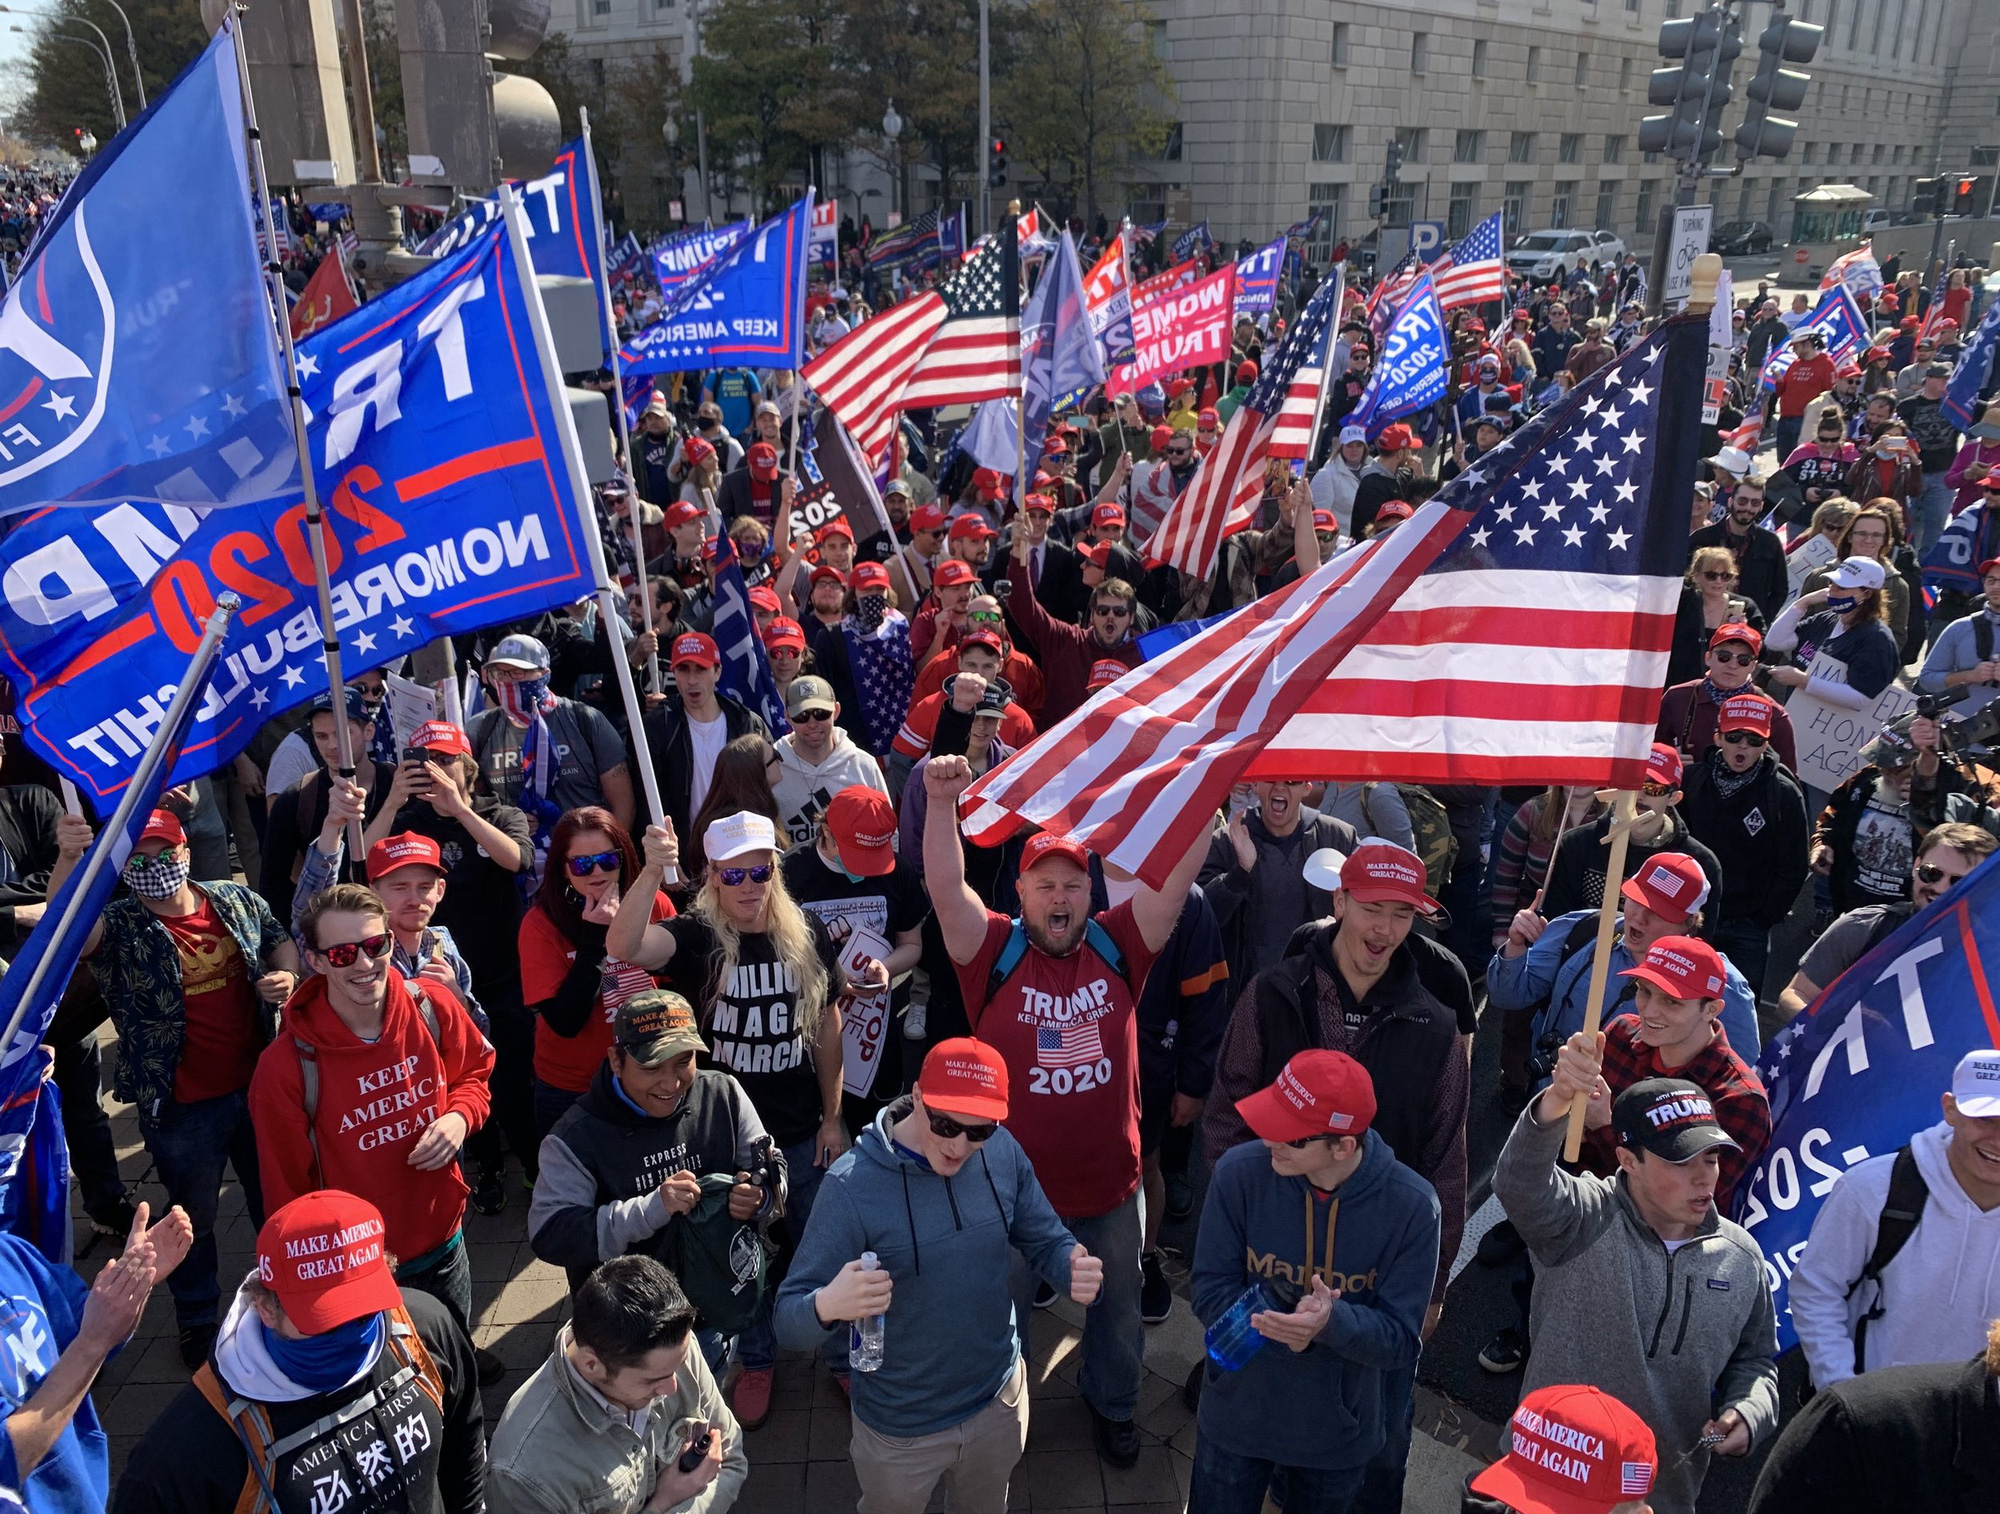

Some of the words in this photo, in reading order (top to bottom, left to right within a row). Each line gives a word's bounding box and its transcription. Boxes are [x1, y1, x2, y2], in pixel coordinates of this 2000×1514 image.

[1682, 218, 1704, 233] TURNING
[1413, 224, 1439, 249] P
[1101, 508, 1119, 518] USA
[1725, 701, 1742, 709] MAKE
[1743, 700, 1770, 712] AMERICA
[1727, 709, 1747, 718] GREAT
[1747, 710, 1767, 720] AGAIN
[427, 723, 456, 733] AMERICA
[431, 733, 453, 742] AGAIN
[1809, 707, 1877, 749] HON
[1803, 744, 1859, 778] AGA
[855, 832, 871, 841] MAKE
[870, 832, 892, 841] AMERICA
[857, 839, 876, 847] GREAT
[875, 838, 890, 846] AGAIN
[1035, 841, 1058, 851] GREAT
[386, 842, 405, 854] MAKE
[405, 840, 432, 851] AMERICA
[390, 849, 411, 859] GREAT
[410, 849, 431, 857] AGAIN
[1366, 862, 1390, 870] MAKE
[1390, 862, 1419, 878] AMERICA
[1370, 870, 1395, 878] GREAT
[1395, 873, 1417, 884] AGAIN
[603, 961, 636, 976] AMERIC
[1664, 949, 1697, 972] AMERICA
[1664, 962, 1688, 977] AGAIN
[719, 961, 803, 999] MILLIO
[1021, 978, 1110, 1022] TRUMP
[632, 1011, 659, 1026] MAKE
[660, 1007, 692, 1020] AMERICA
[1086, 1002, 1115, 1022] GREAT
[638, 1020, 669, 1034] GREAT
[669, 1016, 692, 1028] AGAIN
[859, 998, 887, 1062] TOP
[712, 1034, 803, 1073] MARCH
[357, 1055, 419, 1096] KEEP
[945, 1060, 967, 1070] MAKE
[968, 1062, 998, 1076] AMERICA
[947, 1068, 971, 1078] GREAT
[972, 1072, 995, 1083] AGAIN
[1972, 1061, 2000, 1071] MAKE
[1029, 1058, 1113, 1095] 2020
[1976, 1072, 2000, 1081] GRE
[338, 1071, 446, 1134] AMERICA
[1284, 1088, 1305, 1110] AGAIN
[1646, 1099, 1712, 1127] TRUMP
[357, 1104, 439, 1152] GREAT
[643, 1142, 688, 1169] EXPRESS
[635, 1171, 654, 1192] NEW
[680, 1153, 703, 1172] CITY
[286, 1235, 329, 1260] MAKE
[330, 1218, 384, 1251] AMERICA
[297, 1254, 346, 1281] GREAT
[347, 1241, 381, 1270] AGAIN
[292, 1418, 376, 1482] AMERICA
[379, 1383, 421, 1423] FIRST
[1514, 1406, 1542, 1432] MAKE
[1537, 1418, 1604, 1461] AMERICA
[1512, 1431, 1540, 1457] GREAT
[1538, 1450, 1592, 1484] AGAIN
